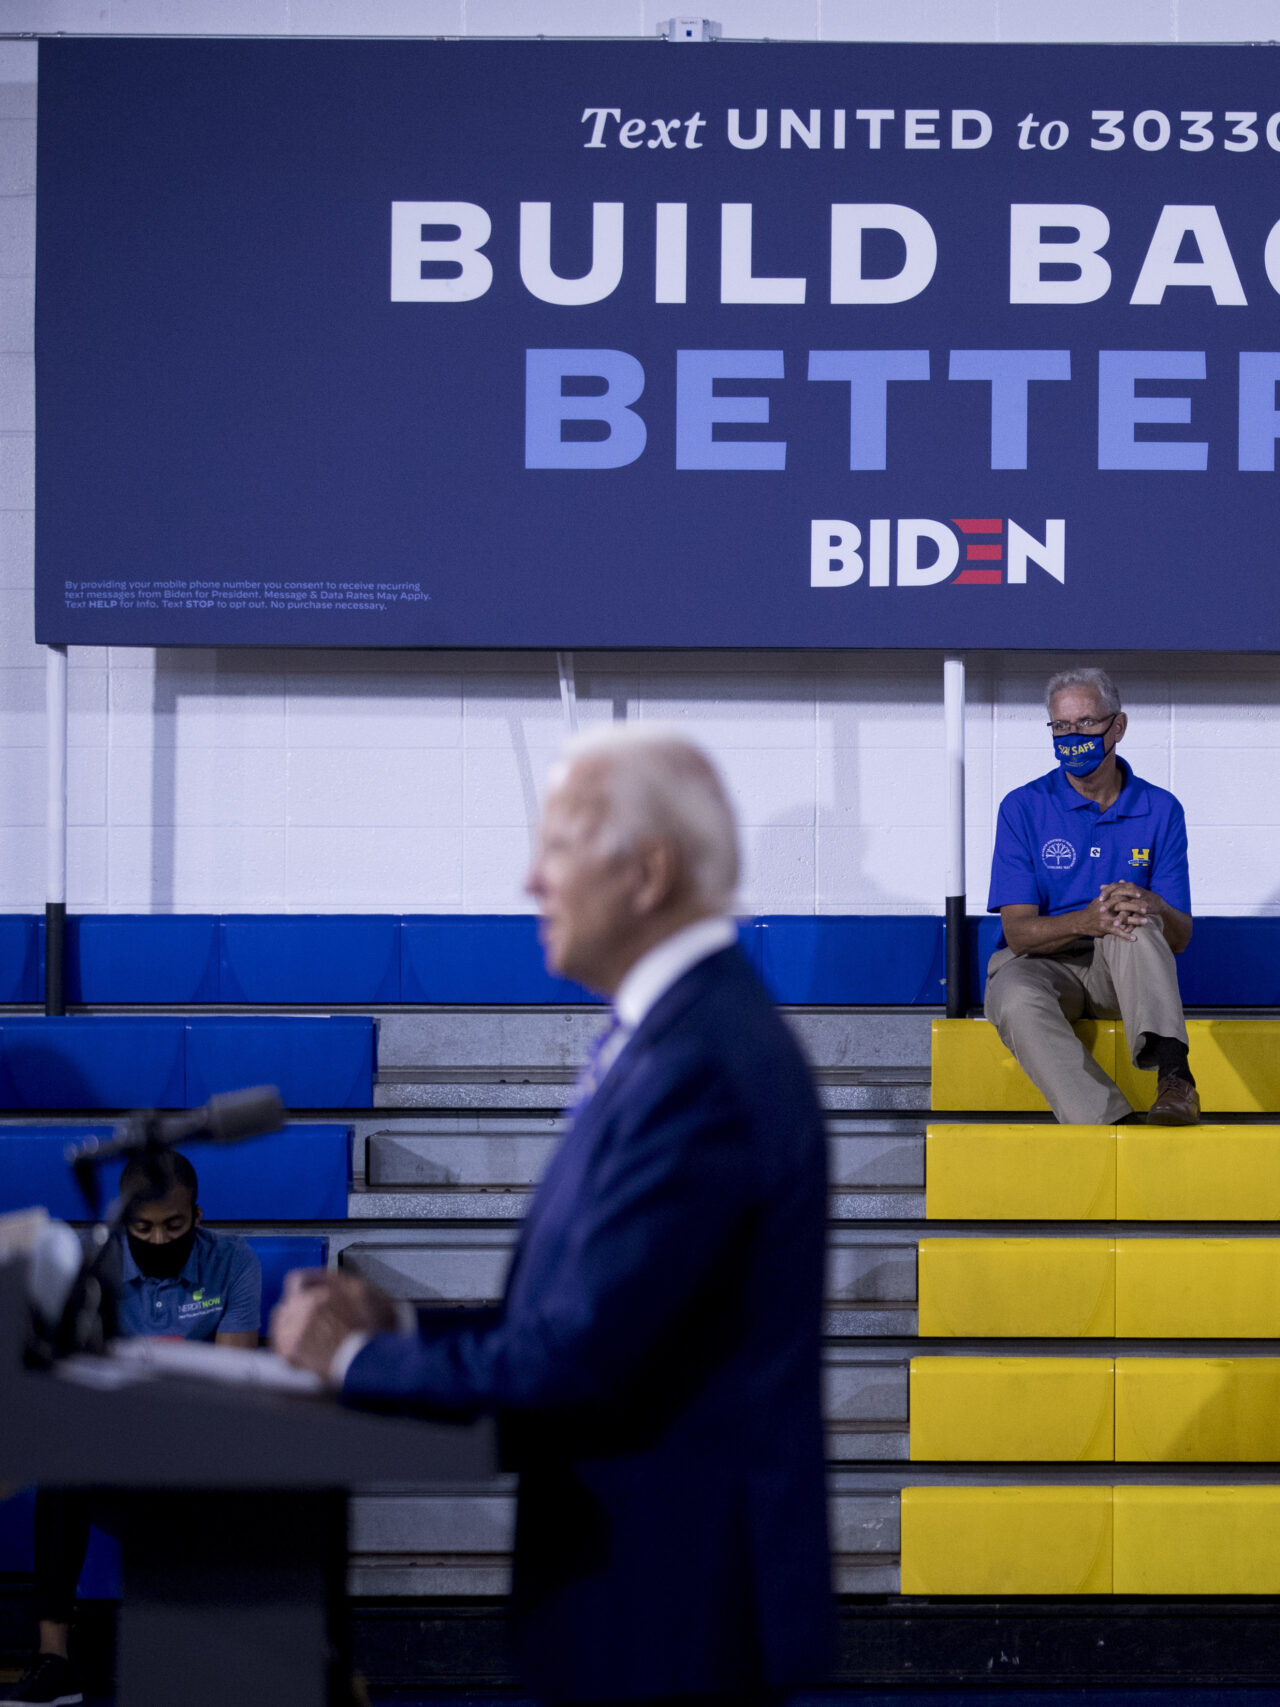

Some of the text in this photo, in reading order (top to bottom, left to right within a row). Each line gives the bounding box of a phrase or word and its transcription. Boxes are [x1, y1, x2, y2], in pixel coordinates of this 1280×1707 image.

[581, 108, 706, 150] Text
[728, 109, 992, 150] UNITED
[1018, 113, 1069, 151] to
[391, 201, 937, 306] BUILD
[810, 517, 1066, 588] BIDEN
[65, 580, 421, 592] By providing your mobile phone number you consent to receive recurring
[64, 590, 84, 599] text
[86, 591, 135, 601] messages
[138, 590, 161, 599] from
[164, 590, 192, 599] Biden
[195, 590, 209, 599] for
[264, 591, 307, 601] Message
[310, 591, 317, 599] &
[320, 591, 343, 600] Data
[346, 591, 375, 600] Rates
[377, 591, 398, 601] May
[400, 592, 432, 602] Apply.
[64, 600, 86, 608] Text
[89, 600, 118, 608] HELP
[120, 600, 134, 608] for
[162, 600, 183, 608] Text
[186, 600, 214, 608] STOP
[217, 600, 227, 608] to
[229, 601, 246, 610] opt
[271, 601, 285, 609] No
[287, 601, 332, 610] purchase
[1071, 741, 1095, 756] SAFE
